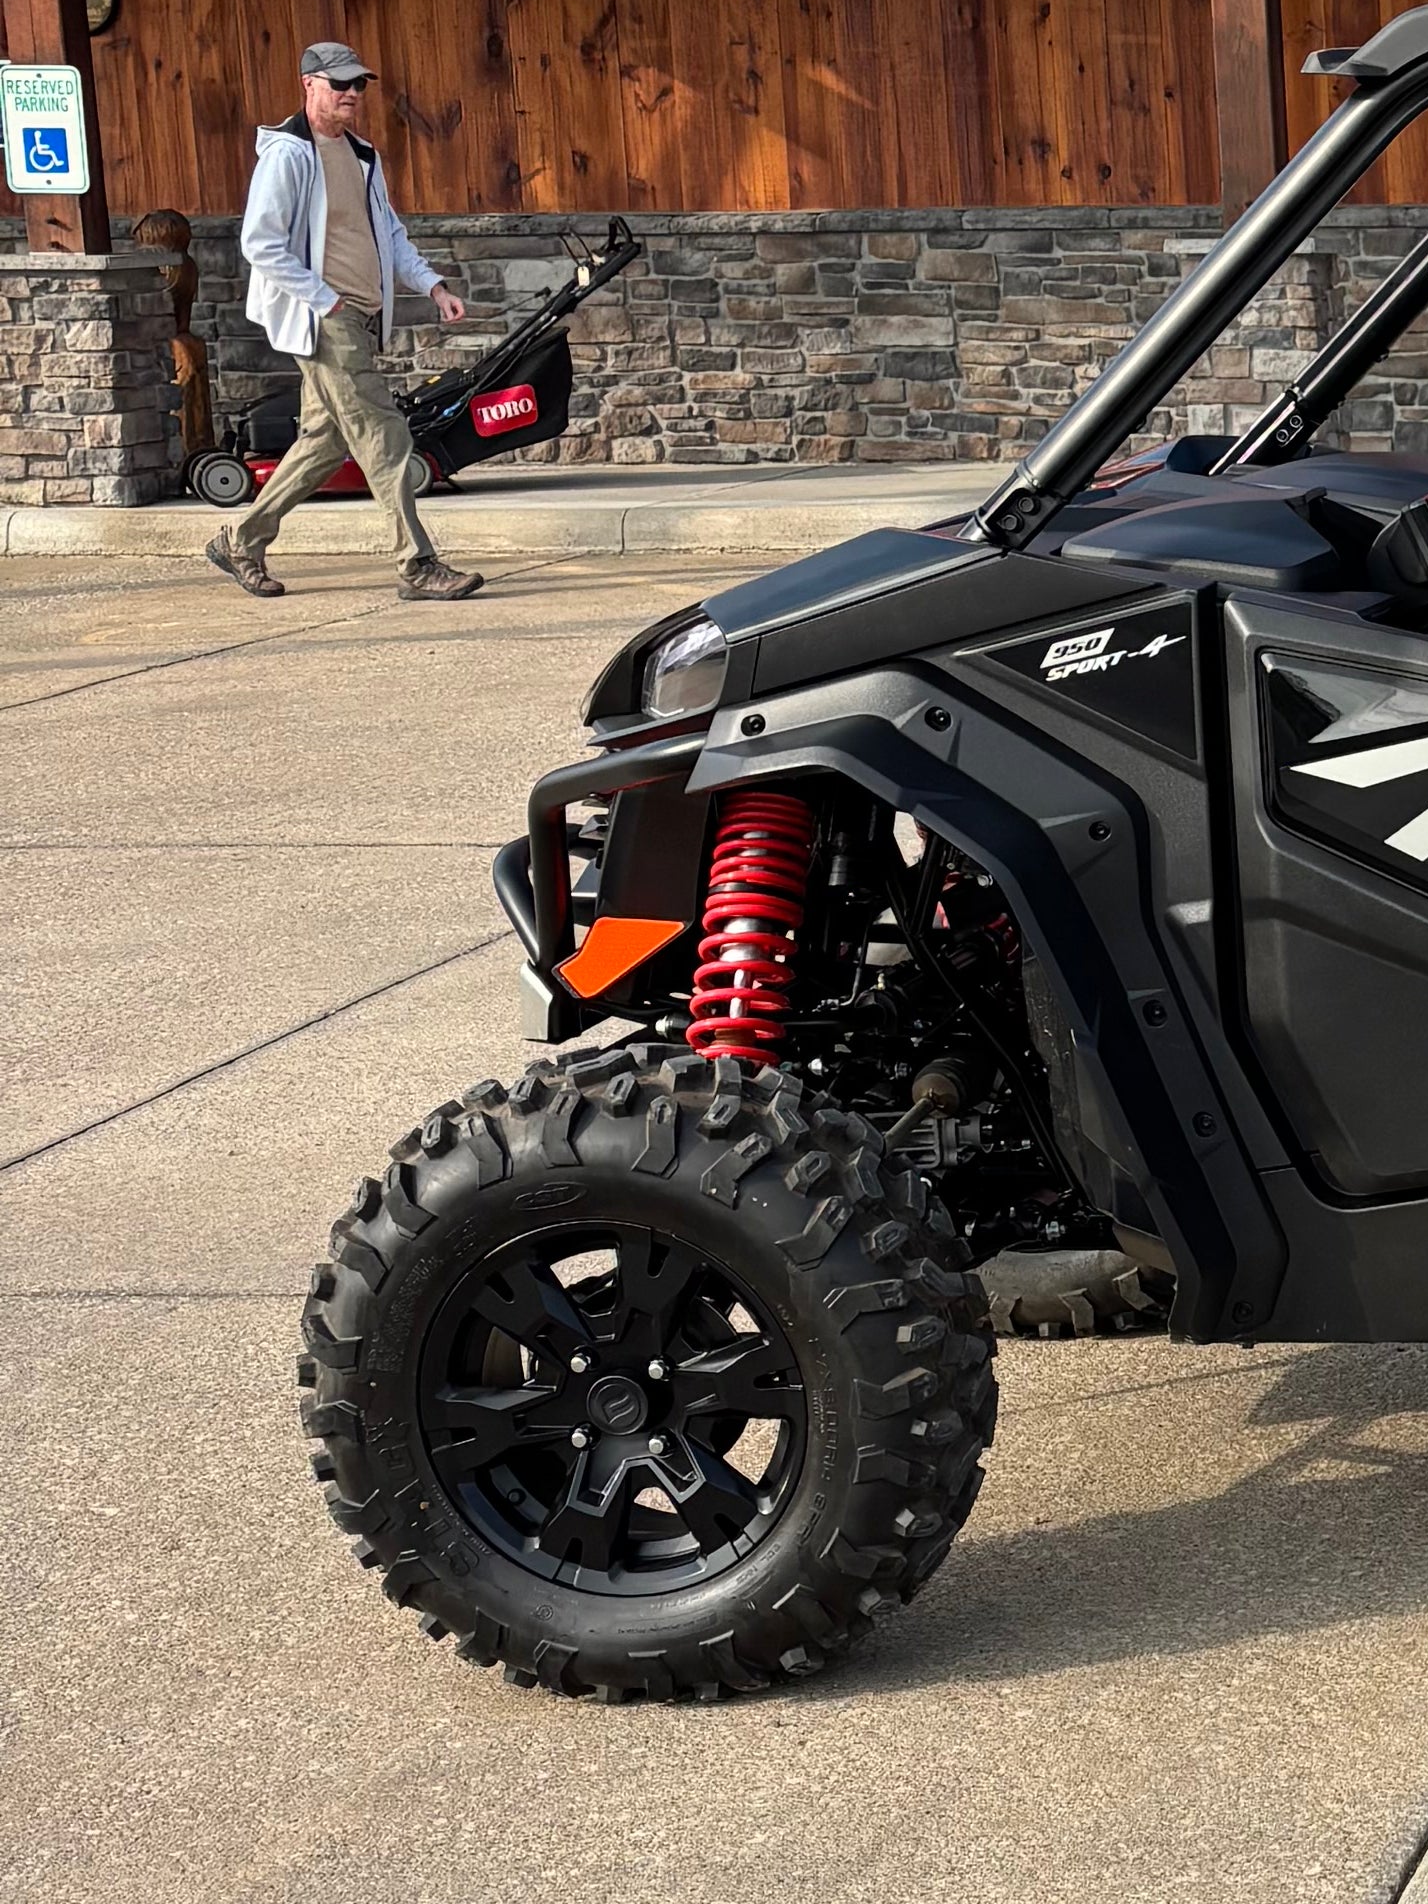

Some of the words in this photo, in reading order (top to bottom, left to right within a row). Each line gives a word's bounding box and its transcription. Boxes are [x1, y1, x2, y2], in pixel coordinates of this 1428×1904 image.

[6, 79, 74, 95] RESERVED
[14, 97, 69, 112] PARKING
[476, 397, 534, 424] TORO
[1053, 637, 1102, 659] 950
